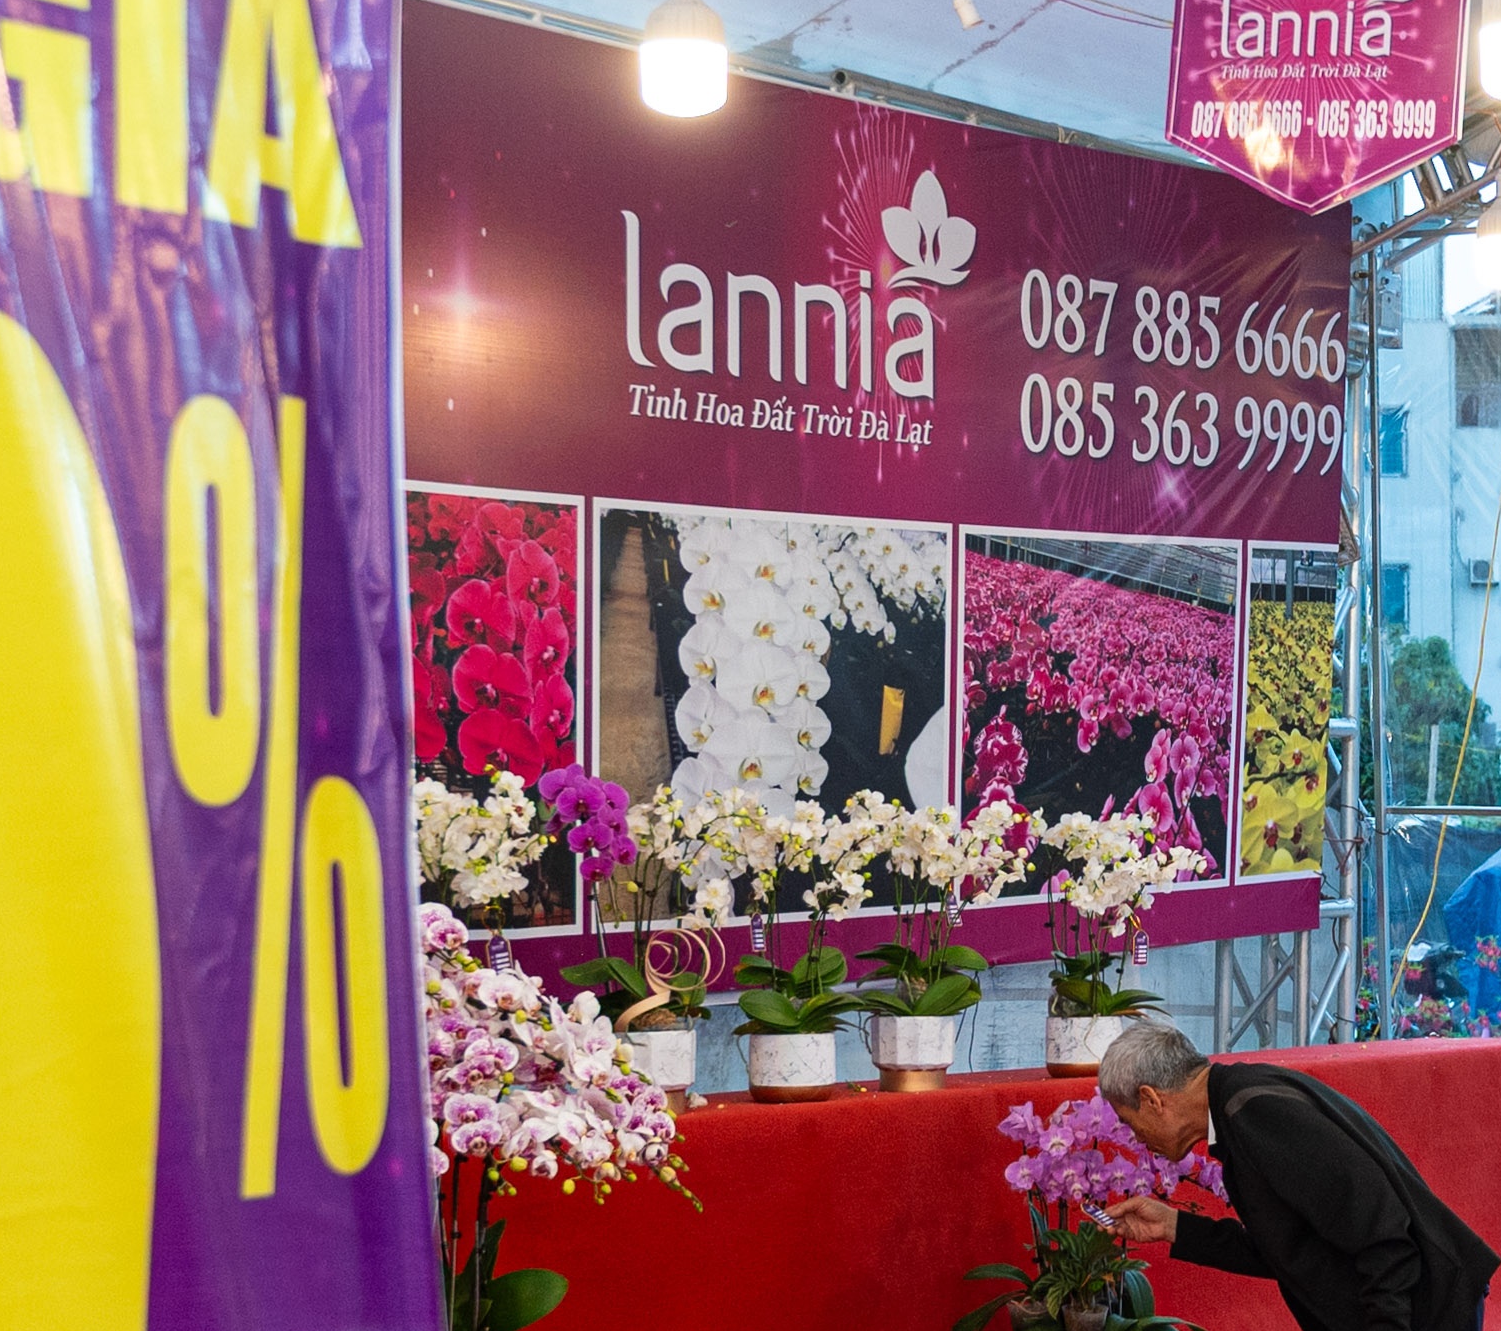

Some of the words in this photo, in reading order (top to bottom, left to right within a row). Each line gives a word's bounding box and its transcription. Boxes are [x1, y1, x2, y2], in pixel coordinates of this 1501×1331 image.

[1252, 65, 1279, 79] Hoa
[1343, 62, 1362, 79] Đà
[1190, 100, 1225, 139] 087
[1316, 99, 1351, 139] 085
[1354, 99, 1389, 140] 363
[1392, 99, 1437, 140] 9999
[621, 210, 934, 400] lannia
[1020, 268, 1118, 357] 087
[1132, 285, 1222, 370] 885
[1235, 300, 1346, 384] 6666
[628, 383, 688, 421] Tinh
[694, 392, 745, 427] Hoa
[750, 396, 796, 433] Đất
[801, 404, 853, 438] Trời
[858, 409, 890, 442] Đà
[895, 413, 934, 453] Lạt
[1020, 372, 1115, 459] 085
[1132, 385, 1220, 467] 363
[1234, 396, 1343, 476] 9999
